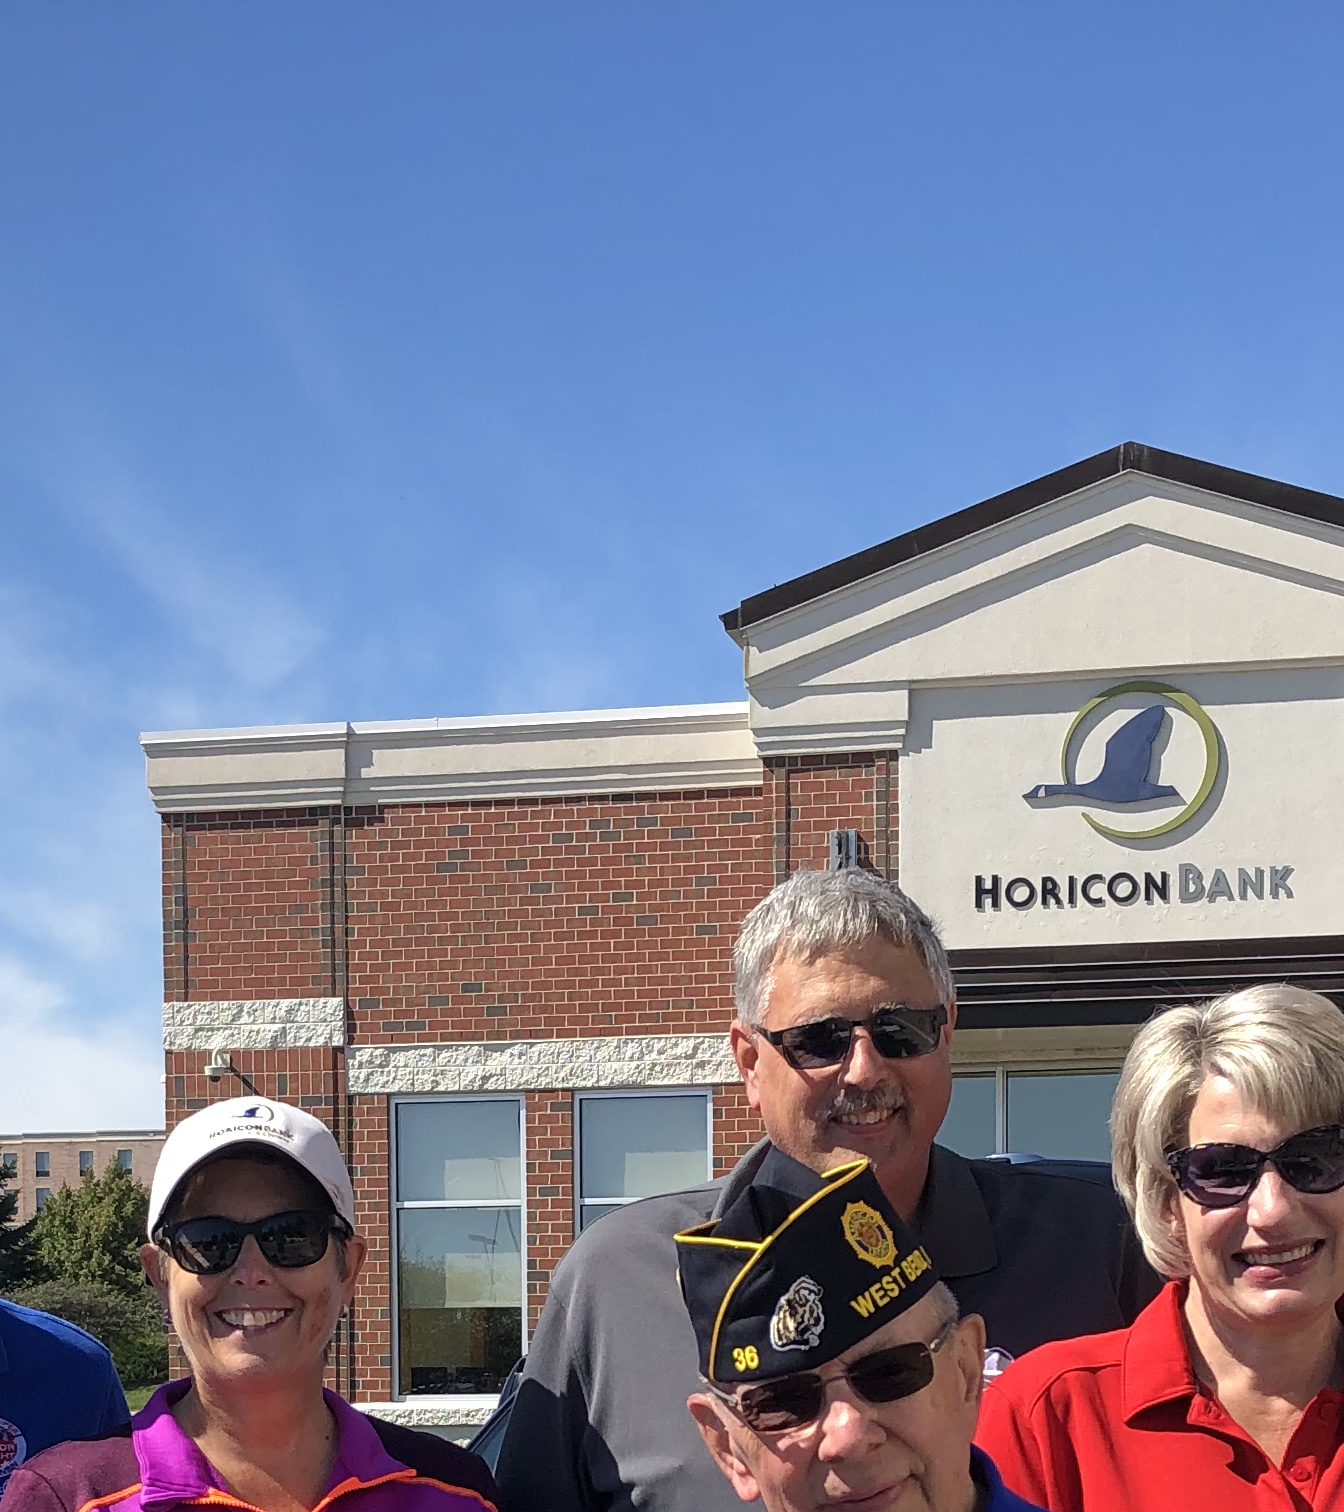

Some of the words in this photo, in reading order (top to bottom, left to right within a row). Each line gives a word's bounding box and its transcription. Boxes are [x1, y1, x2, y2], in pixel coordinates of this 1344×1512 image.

[975, 871, 1170, 910] HORICON
[1178, 862, 1296, 901] BANK
[850, 1266, 907, 1318] WEST
[732, 1345, 760, 1372] 36
